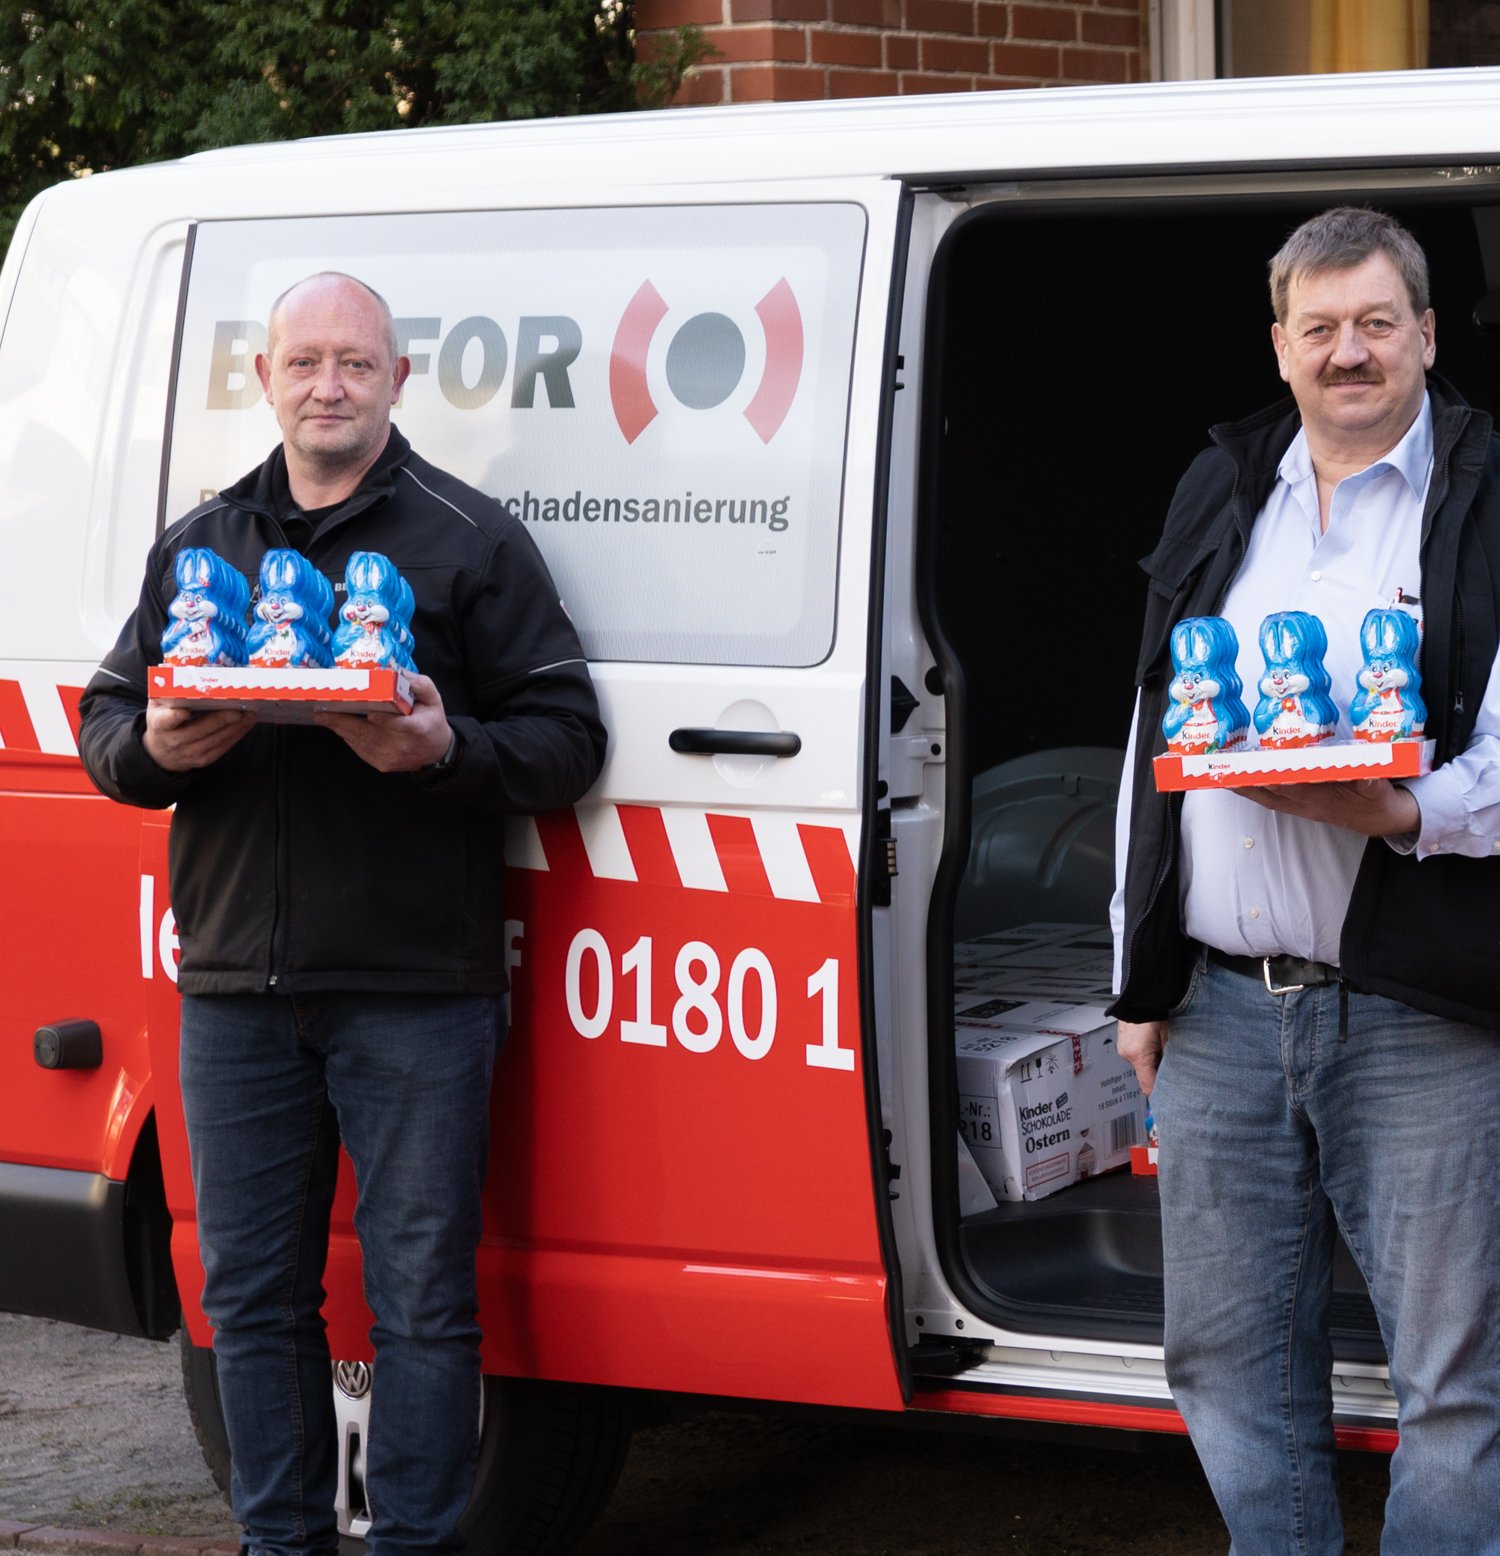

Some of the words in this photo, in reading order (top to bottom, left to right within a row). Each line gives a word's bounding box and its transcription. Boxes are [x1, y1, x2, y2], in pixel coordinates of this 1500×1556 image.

[206, 315, 583, 410] BFOR
[492, 490, 791, 532] chadensanierung
[565, 928, 778, 1060] 0180
[806, 958, 855, 1071] 1
[1026, 1129, 1071, 1154] Ostern
